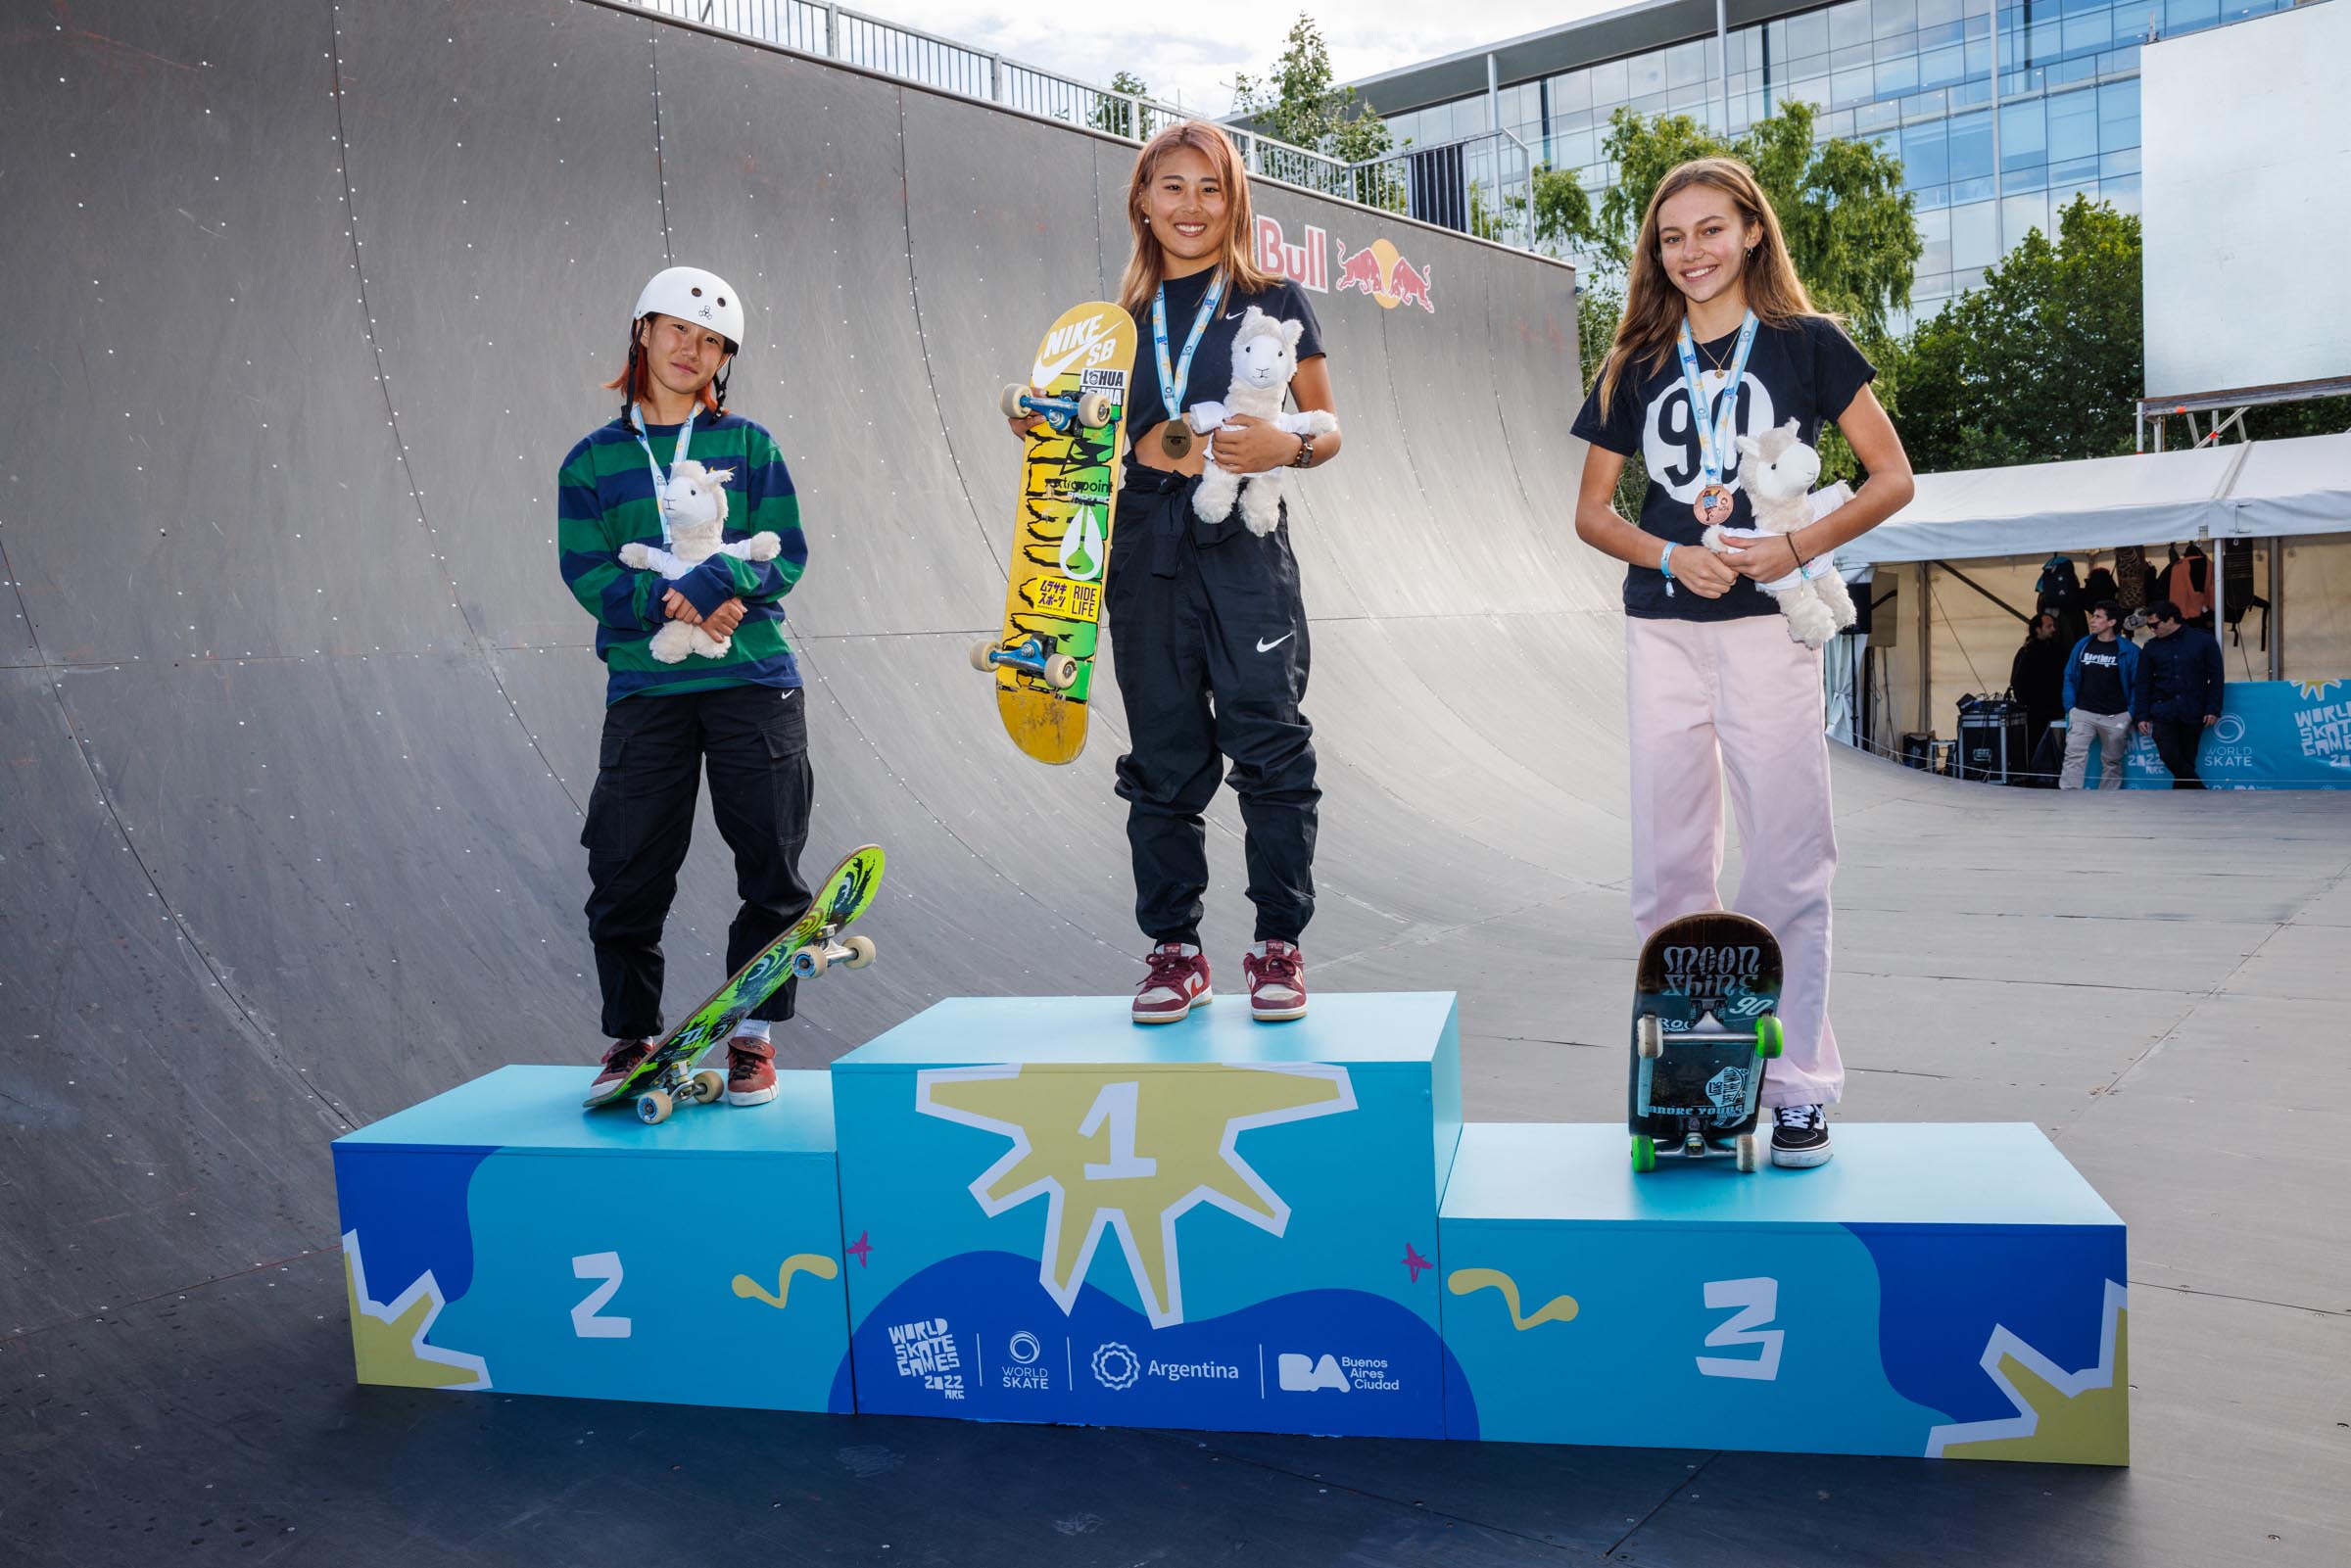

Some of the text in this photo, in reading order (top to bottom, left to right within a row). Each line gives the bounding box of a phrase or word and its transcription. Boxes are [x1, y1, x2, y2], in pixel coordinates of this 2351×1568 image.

[1258, 217, 1326, 291] Bull
[1043, 313, 1104, 359] NIKE
[1085, 338, 1116, 366] SB
[1657, 380, 1751, 488] 90
[1073, 585, 1097, 602] RIDE
[1071, 599, 1095, 617] LIFE
[2299, 718, 2351, 742] SKAT
[2206, 746, 2252, 756] WORLD
[2301, 735, 2351, 756] GAME
[2204, 756, 2252, 767] SKATE
[1729, 996, 1774, 1017] 90
[1079, 1081, 1157, 1180] 1
[570, 1251, 632, 1338] 2
[888, 1318, 948, 1345] WORLD
[1695, 1276, 1785, 1381] 3
[894, 1334, 957, 1360] SKATE
[896, 1352, 960, 1377] GAMES
[1001, 1366, 1048, 1378] WORLD
[1147, 1359, 1239, 1381] Argentina
[1341, 1356, 1388, 1368] Buenos
[924, 1375, 964, 1390] 2022
[1002, 1377, 1049, 1390] SKATE
[1350, 1368, 1384, 1379] Aires
[1354, 1379, 1400, 1391] Ciudad
